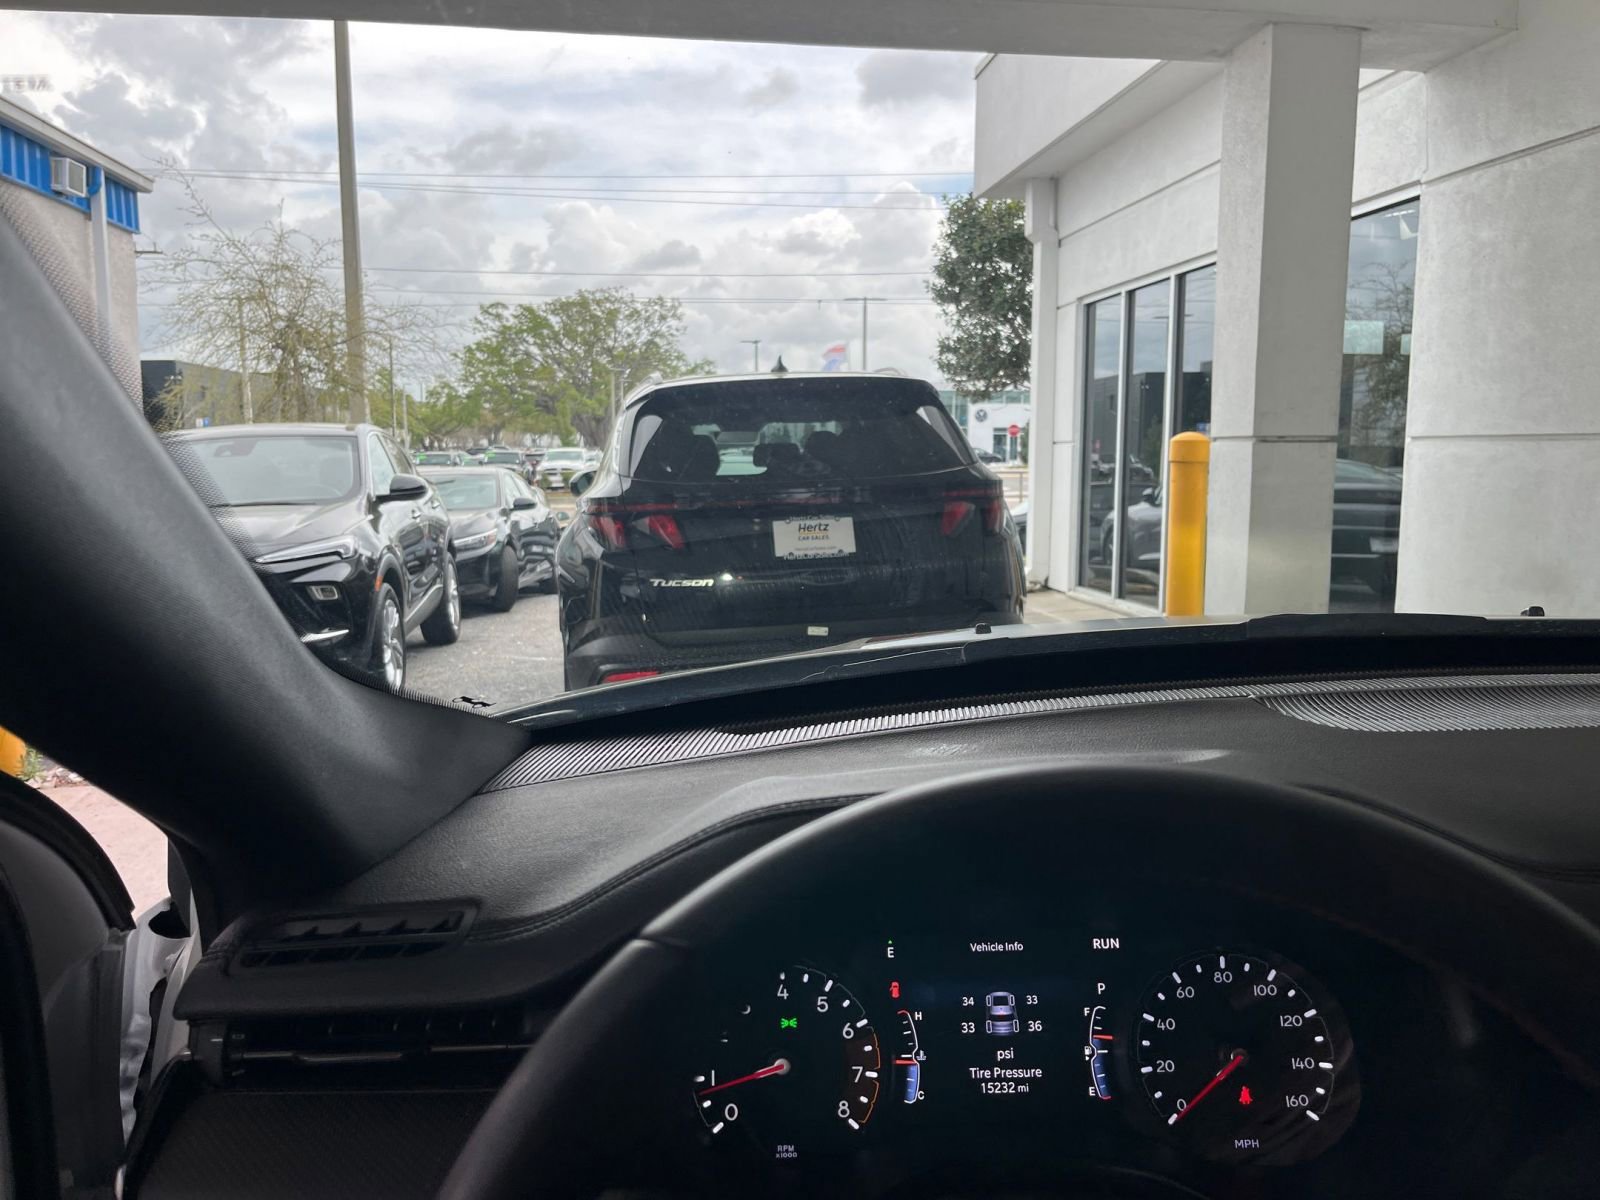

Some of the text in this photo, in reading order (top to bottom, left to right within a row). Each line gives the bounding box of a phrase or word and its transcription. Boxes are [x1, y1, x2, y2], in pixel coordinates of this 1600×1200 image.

[798, 523, 829, 532] Hertz
[649, 578, 715, 587] TUCSON
[969, 941, 1024, 952] Vehicle Info
[1092, 937, 1120, 950] RUN
[887, 946, 895, 959] E
[1213, 970, 1233, 984] 80
[776, 984, 789, 1000] 4
[1097, 982, 1106, 995] P
[1176, 986, 1195, 999] 60
[1252, 984, 1278, 997] 100
[816, 996, 829, 1013] 5
[961, 996, 975, 1007] 34
[1026, 994, 1039, 1005] 33
[914, 1011, 923, 1021] H
[1083, 1007, 1091, 1017] F
[960, 1021, 976, 1034] 33
[1027, 1020, 1043, 1032] 36
[1156, 1017, 1176, 1031] 40
[1279, 1014, 1303, 1028] 120
[842, 1022, 855, 1040] 6
[996, 1047, 1015, 1061] psi
[1156, 1059, 1175, 1073] 20
[1291, 1057, 1315, 1070] 140
[851, 1066, 864, 1084] 7
[969, 1066, 1043, 1079] Tire Pressure
[917, 1089, 925, 1101] C
[980, 1082, 1030, 1095] 15232 mi
[1088, 1085, 1096, 1097] E
[1176, 1098, 1187, 1111] 0
[1285, 1094, 1309, 1108] 160
[724, 1103, 739, 1121] 0
[837, 1100, 850, 1118] 8
[777, 1144, 795, 1152] RPM
[1234, 1139, 1260, 1149] MPH
